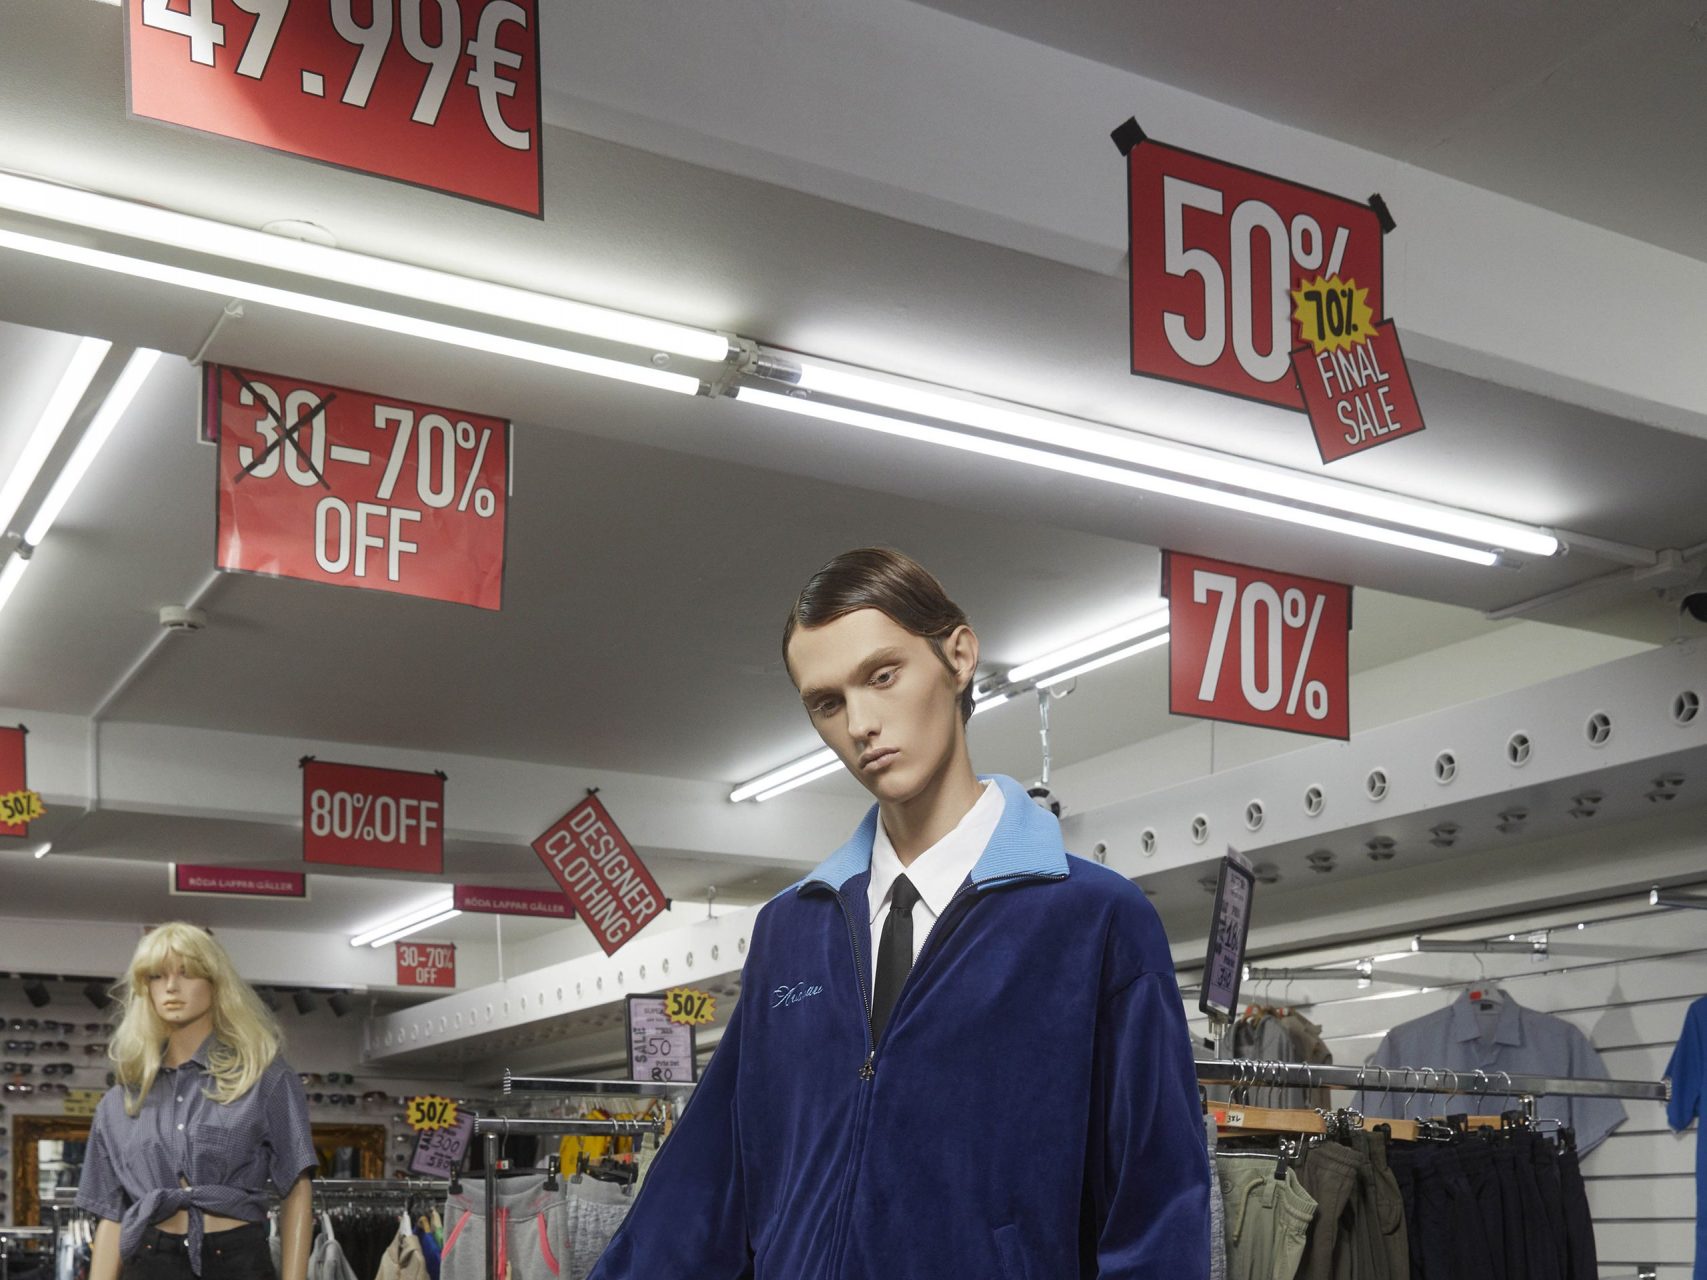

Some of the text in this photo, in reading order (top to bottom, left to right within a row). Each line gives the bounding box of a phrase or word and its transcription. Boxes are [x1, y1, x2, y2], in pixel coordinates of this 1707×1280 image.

[1304, 288, 1358, 341] 70%
[1316, 338, 1389, 398] FINAL
[1336, 386, 1401, 445] SALE
[314, 495, 422, 582] OFF
[1193, 569, 1328, 720] 70%
[2, 795, 36, 820] 50%
[545, 830, 631, 944] CLOTHING
[569, 806, 657, 924] DESIGNER
[416, 967, 437, 984] OFF
[671, 993, 707, 1019] 50%
[633, 1027, 648, 1063] SALE
[647, 1037, 672, 1056] 50
[415, 1101, 449, 1124] 50%
[419, 1129, 434, 1151] SAL
